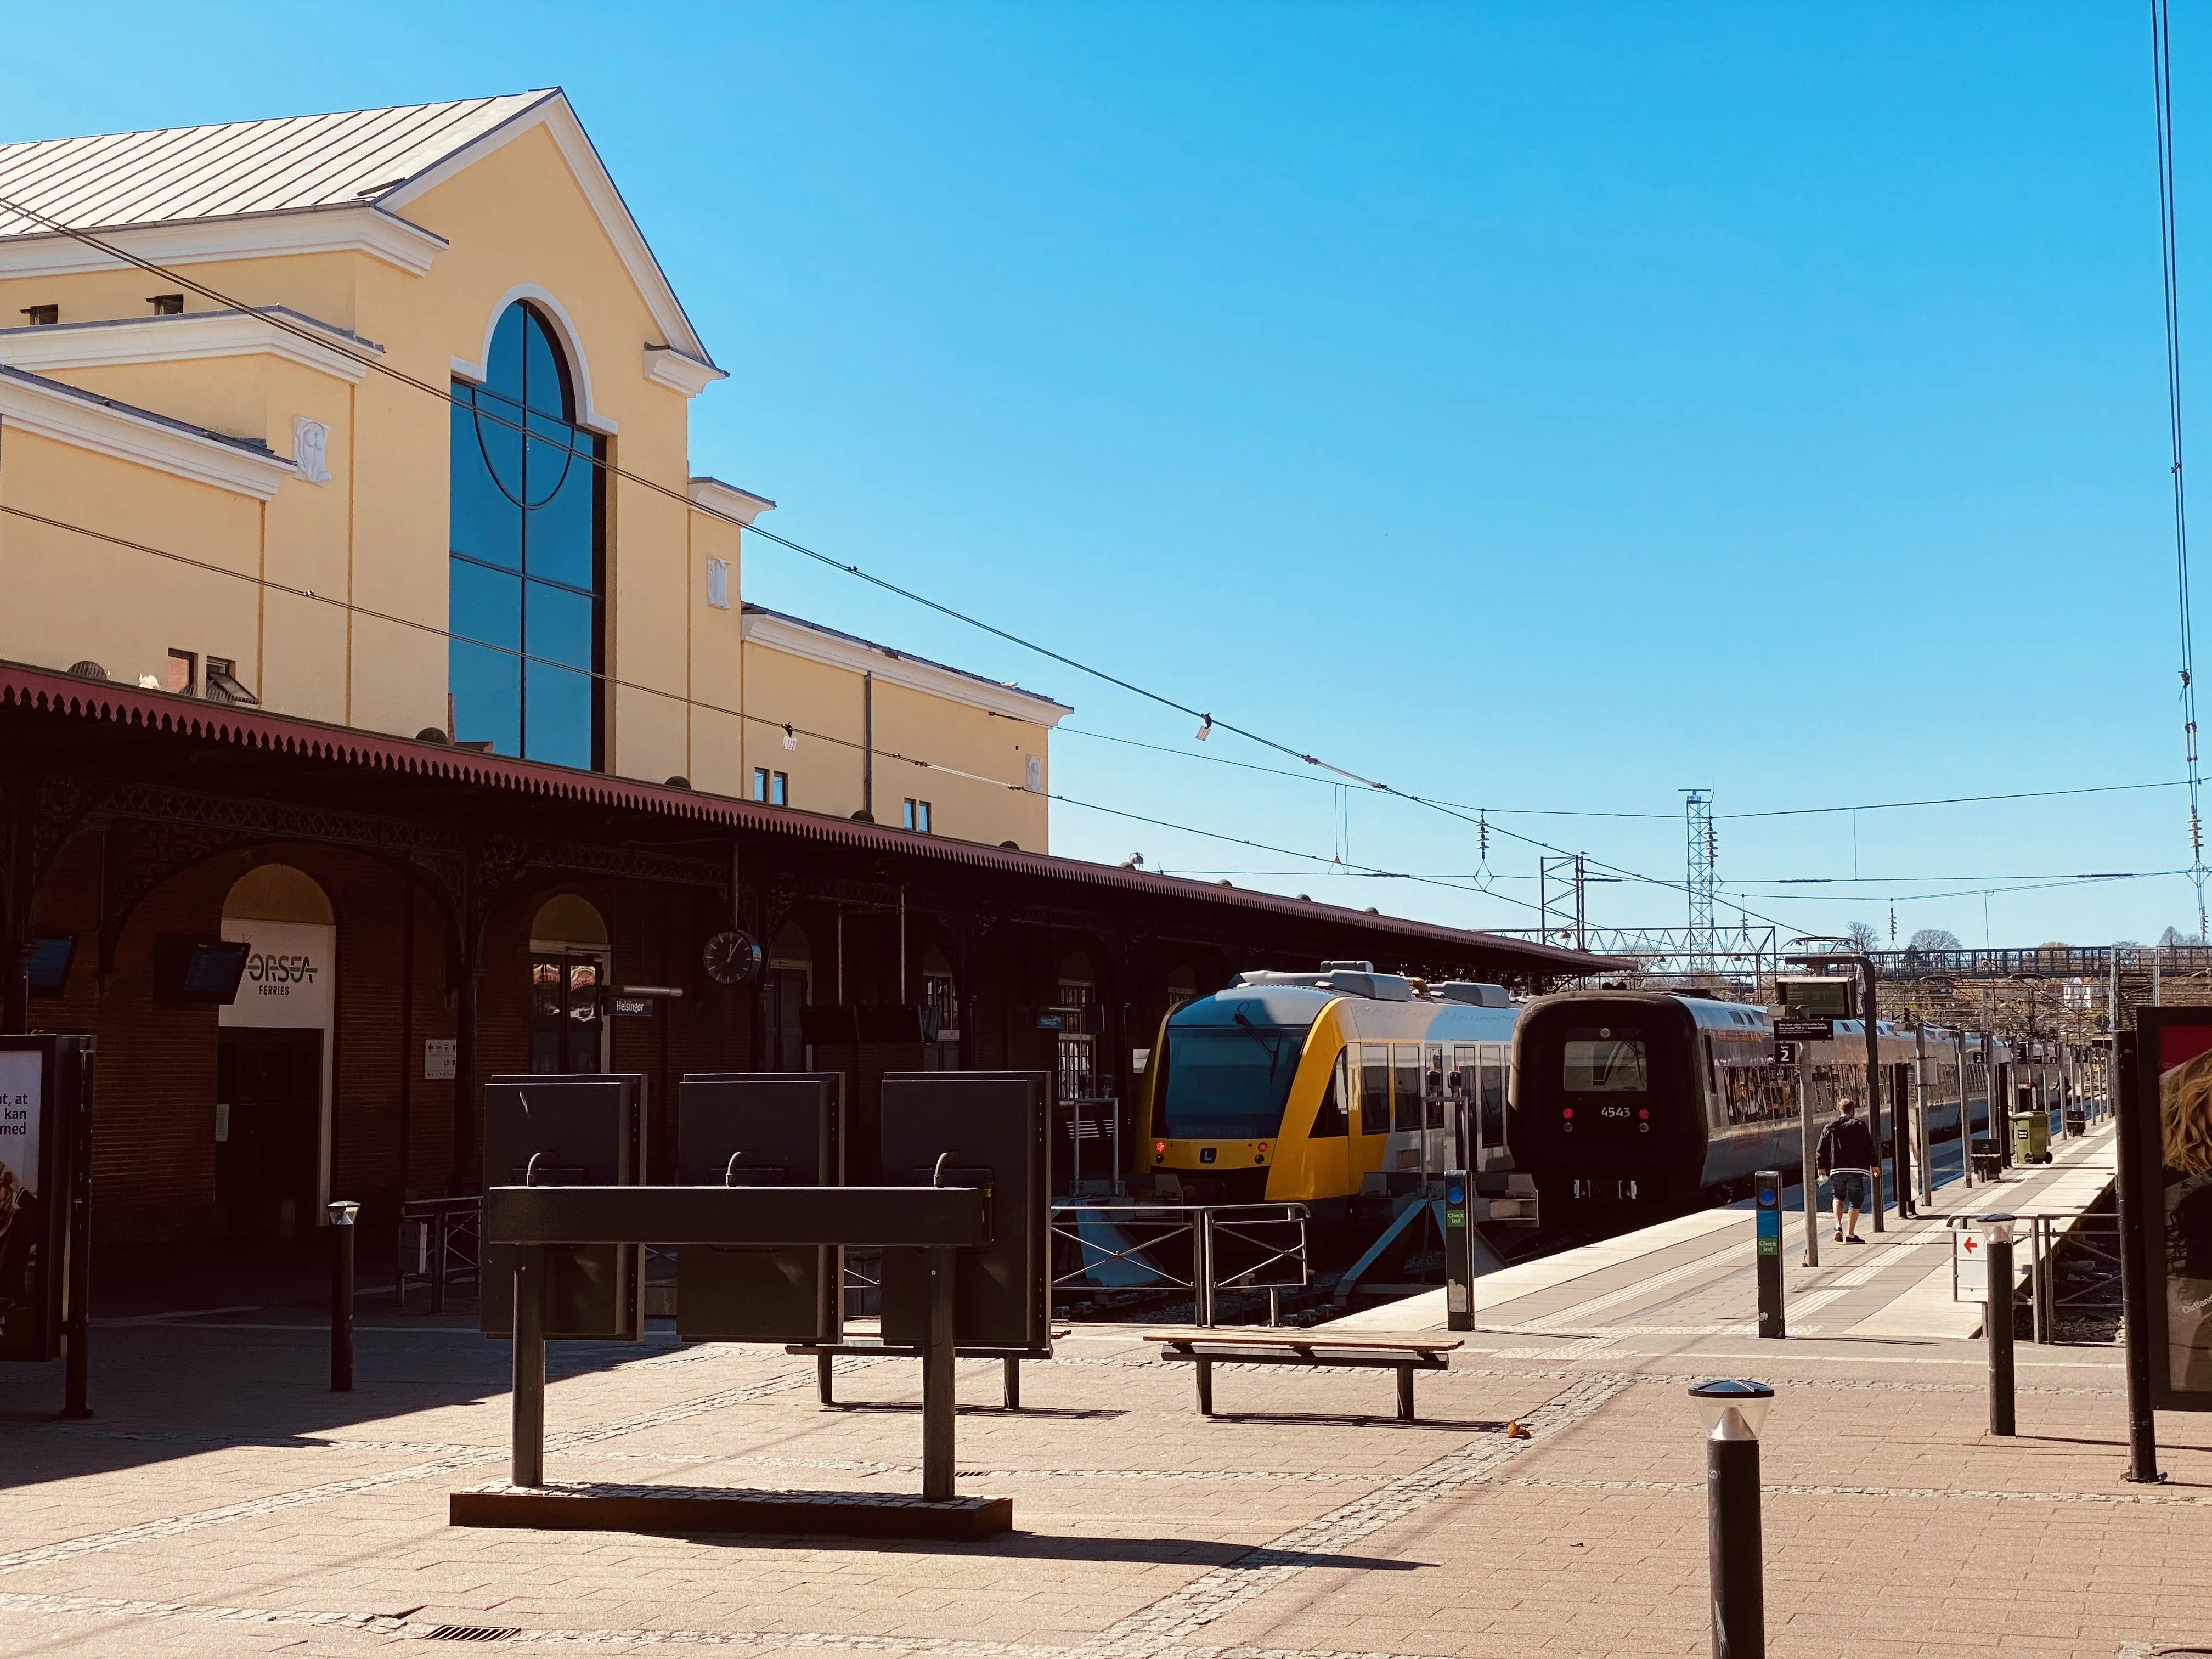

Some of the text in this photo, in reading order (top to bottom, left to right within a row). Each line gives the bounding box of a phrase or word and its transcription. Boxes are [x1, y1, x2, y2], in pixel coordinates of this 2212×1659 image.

[246, 953, 318, 983] ORSEA
[259, 985, 289, 996] FERRIES
[617, 1000, 644, 1013] Helsingør
[1781, 1049, 1789, 1062] 2
[15, 1094, 28, 1104] at
[4, 1107, 26, 1120] kan
[1601, 1107, 1630, 1118] 4543
[1204, 1150, 1212, 1161] L
